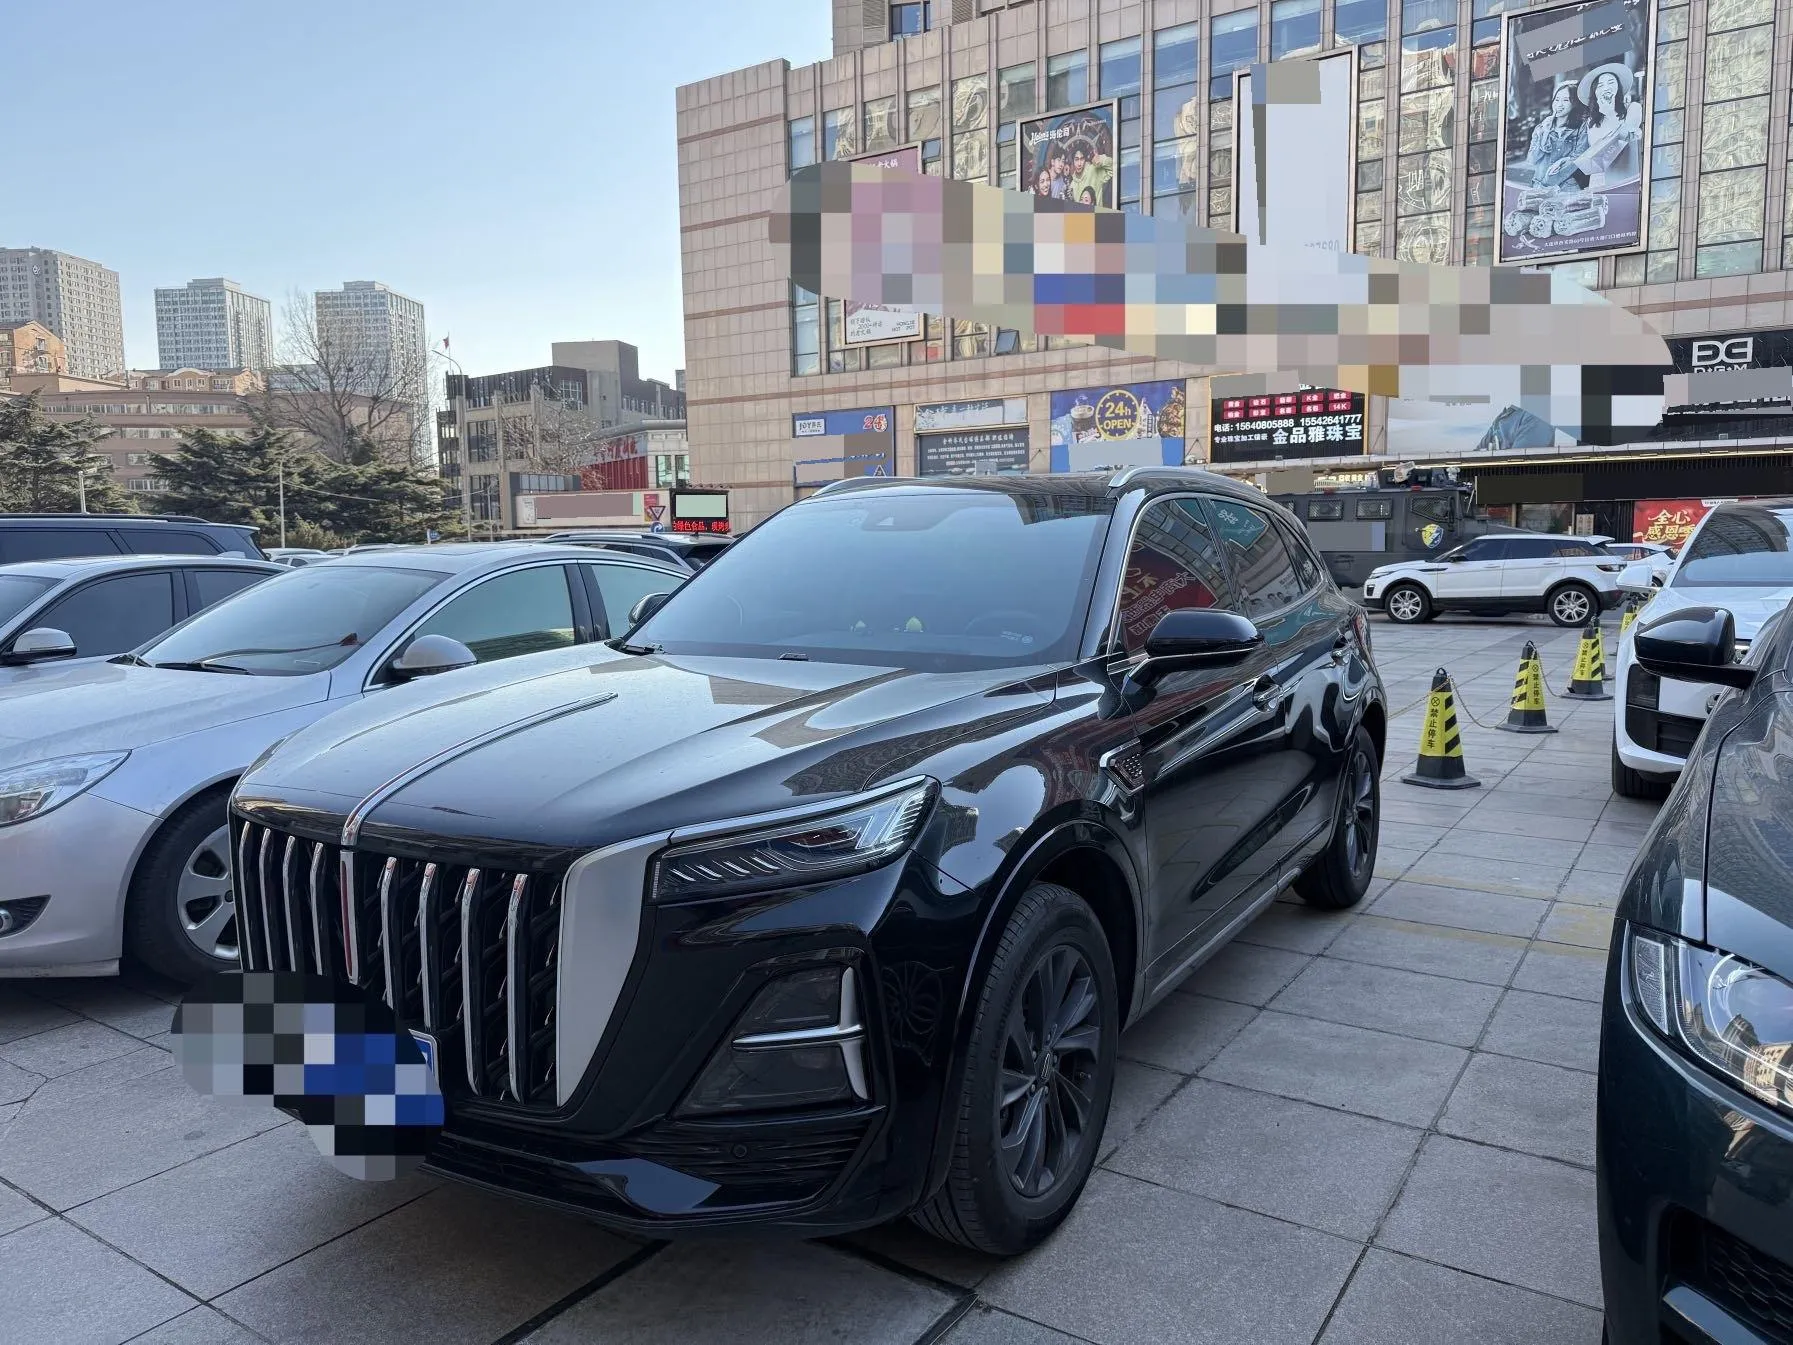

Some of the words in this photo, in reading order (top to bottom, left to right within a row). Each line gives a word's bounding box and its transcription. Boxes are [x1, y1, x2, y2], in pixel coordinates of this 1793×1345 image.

[1105, 401, 1131, 417] 24h
[1103, 418, 1132, 430] OPEN
[1299, 413, 1363, 426] 15542641777
[1272, 423, 1363, 445] 金品雅珠宝
[1647, 509, 1691, 525] 全心
[1532, 673, 1540, 705] 禁止停车
[1426, 708, 1440, 749] 禁止停车
